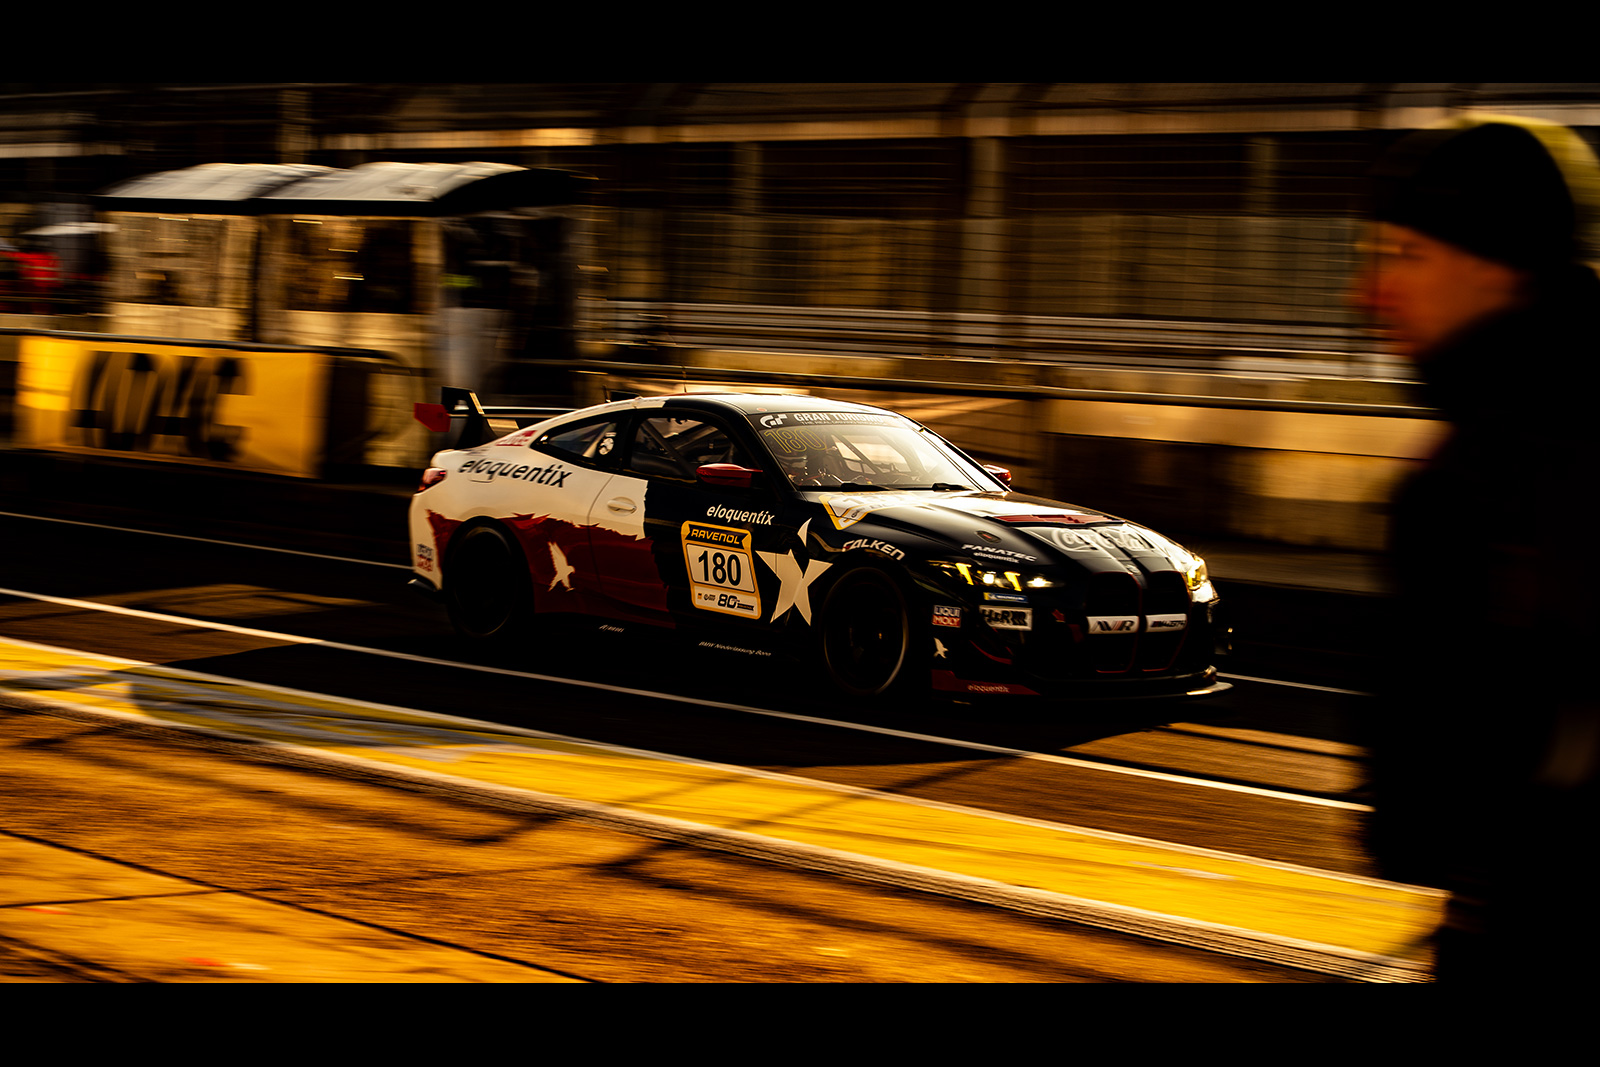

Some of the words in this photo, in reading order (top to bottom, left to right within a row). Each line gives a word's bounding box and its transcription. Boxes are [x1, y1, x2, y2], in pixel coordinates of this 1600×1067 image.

[793, 413, 830, 422] GRAN
[763, 428, 827, 453] 180
[458, 459, 572, 488] eloquentix
[706, 504, 775, 526] eloquentix
[691, 528, 741, 545] RAVENOL
[841, 539, 906, 561] FALKEN
[961, 544, 1037, 562] FANATEC
[698, 551, 741, 586] 180
[933, 616, 960, 626] MOLY
[934, 606, 960, 617] LIQUI
